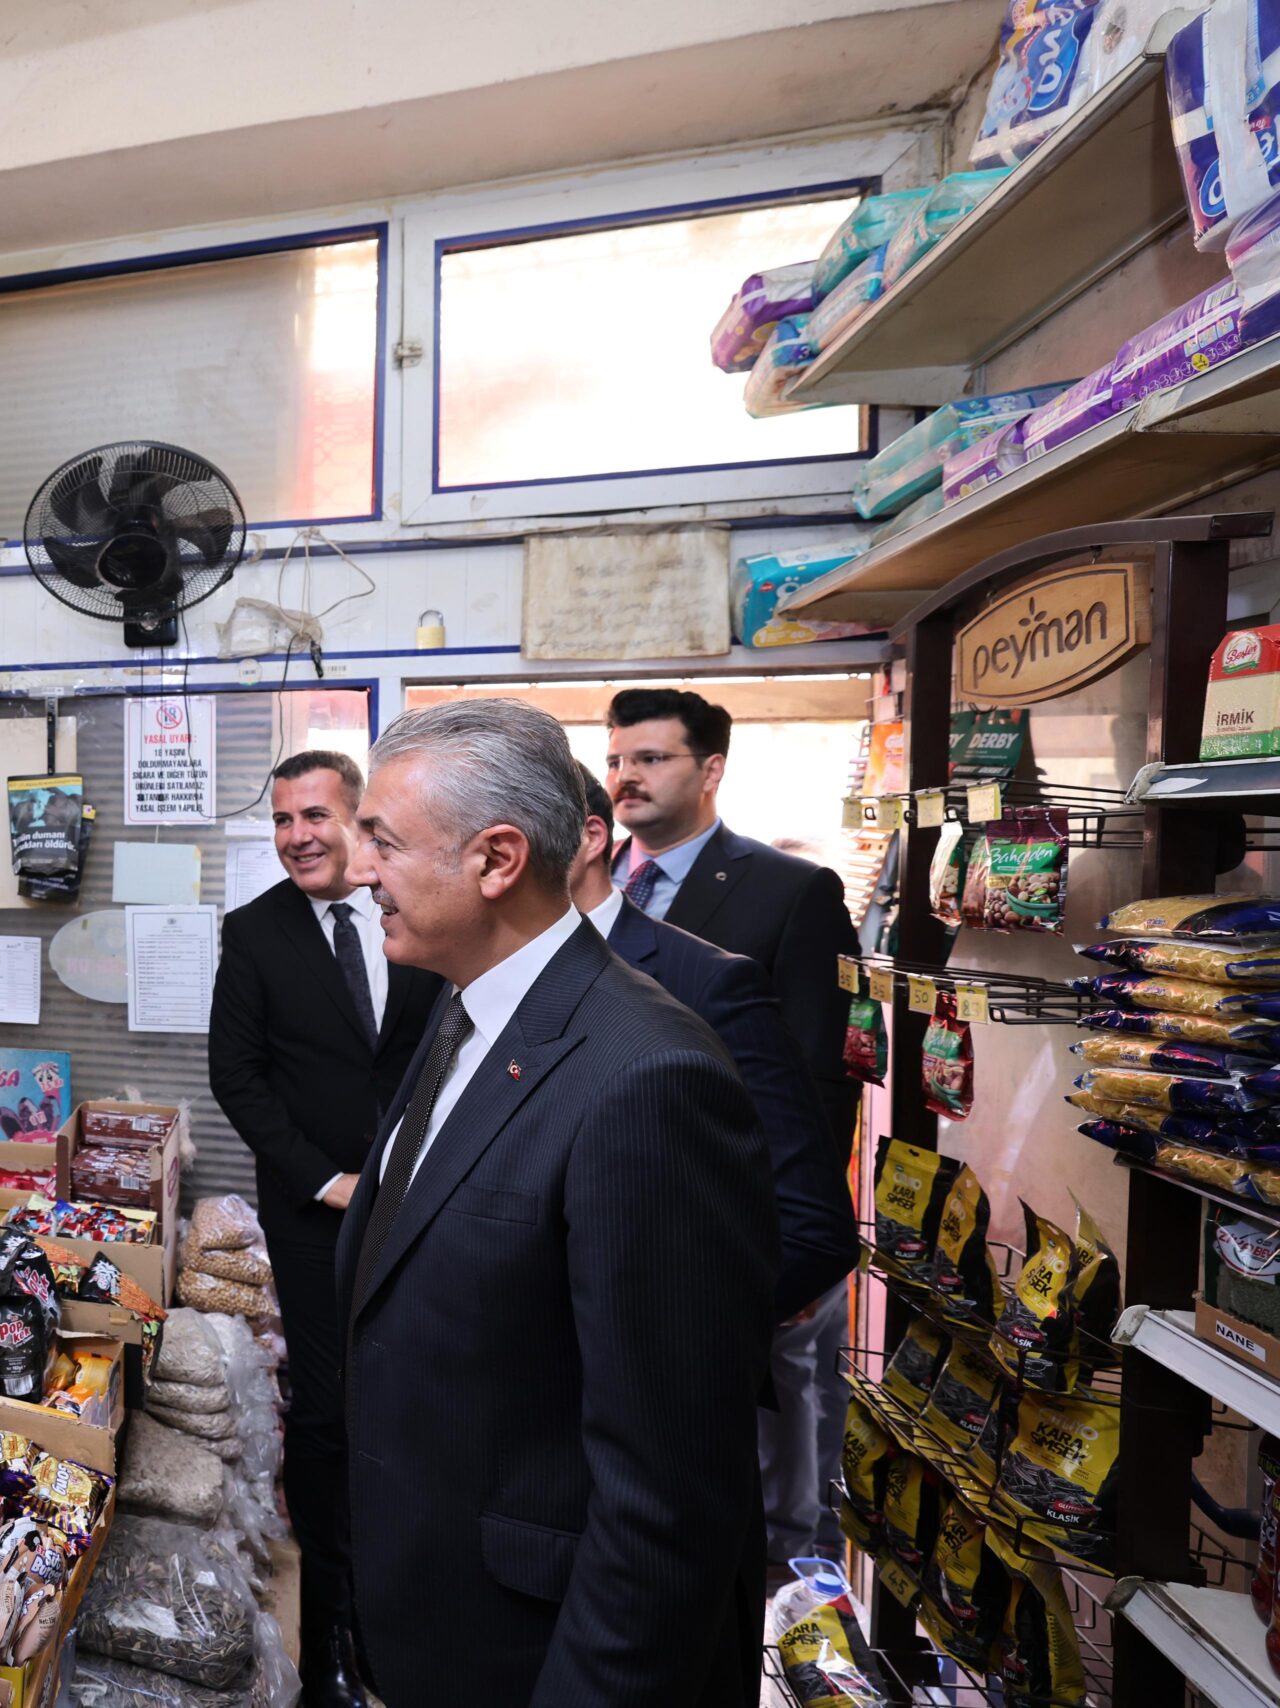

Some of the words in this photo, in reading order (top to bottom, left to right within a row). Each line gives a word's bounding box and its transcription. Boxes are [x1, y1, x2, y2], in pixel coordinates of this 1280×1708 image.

[973, 598, 1108, 689] peyman
[1216, 708, 1256, 728] İRMİK
[144, 735, 167, 744] YASAL
[968, 733, 1019, 749] DERBY
[32, 831, 66, 840] dumanı
[914, 991, 929, 1004] 50
[893, 1184, 916, 1201] KARA
[1216, 1323, 1256, 1352] NANE
[1036, 1422, 1084, 1449] KARA
[50, 1461, 73, 1497] Gong
[1046, 1508, 1080, 1523] KLASİK
[887, 1569, 906, 1597] 45
[784, 1621, 822, 1639] KARA
